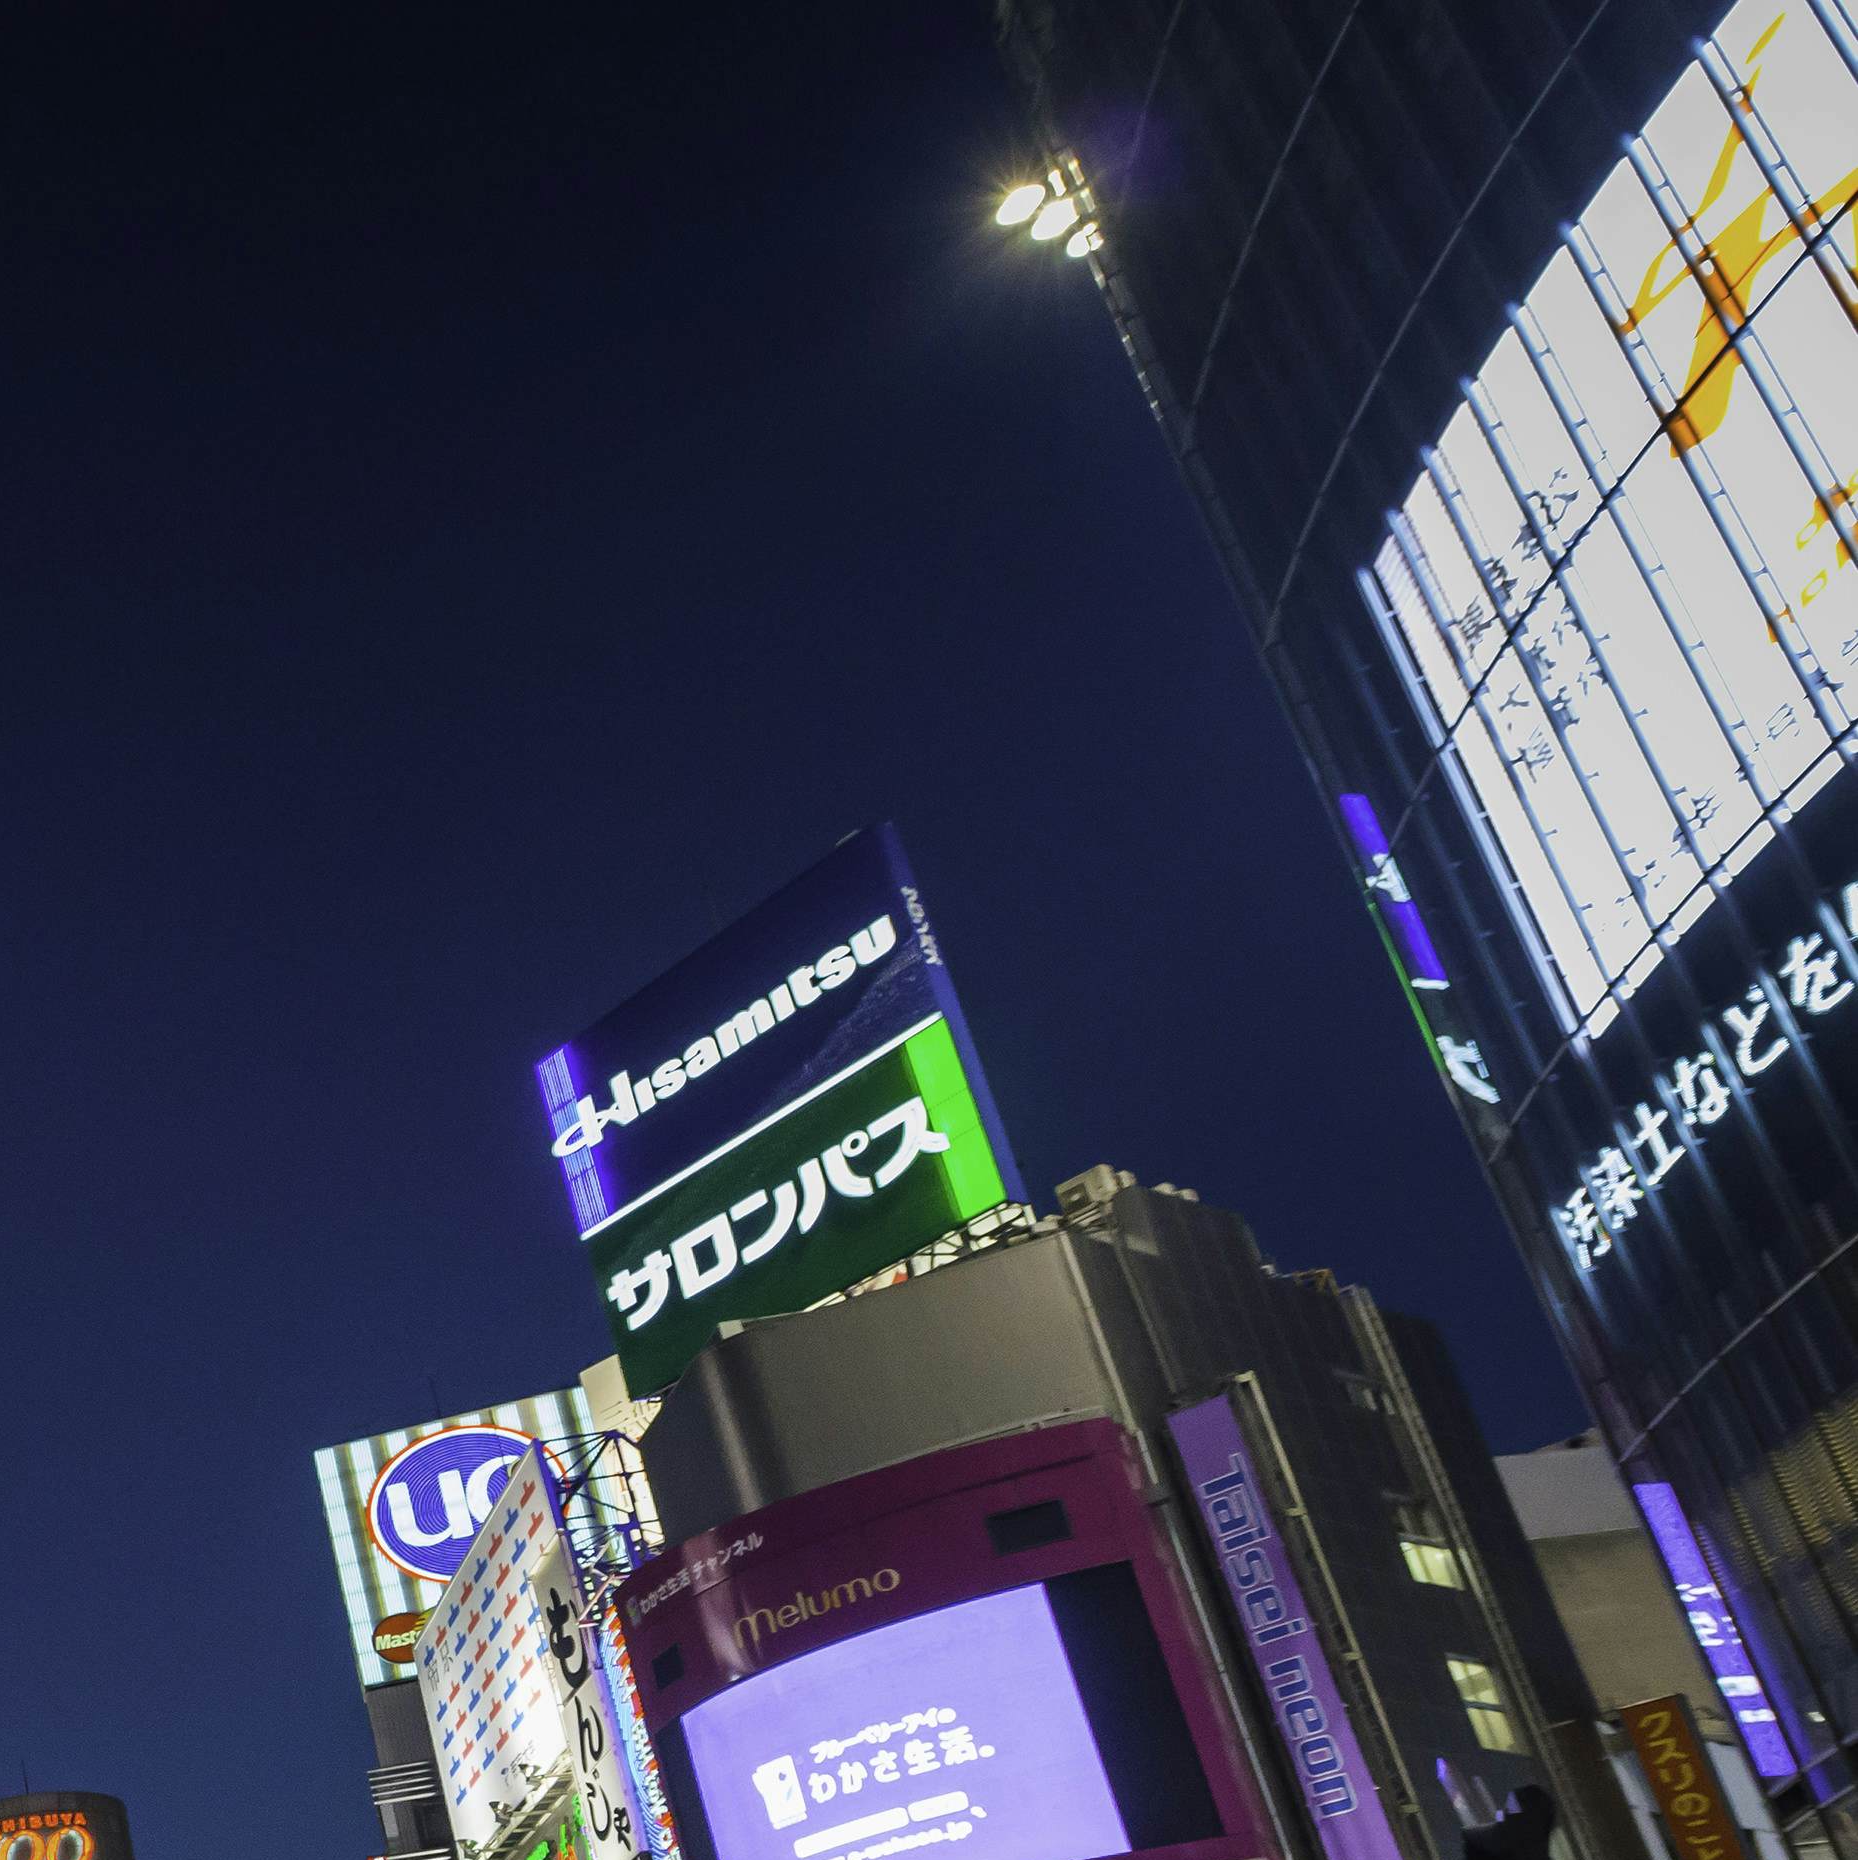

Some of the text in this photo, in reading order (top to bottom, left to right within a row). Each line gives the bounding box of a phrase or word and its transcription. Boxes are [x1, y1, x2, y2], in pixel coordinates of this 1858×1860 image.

[552, 914, 897, 1157] Hisamitsu
[607, 1096, 950, 1331] サロンパス
